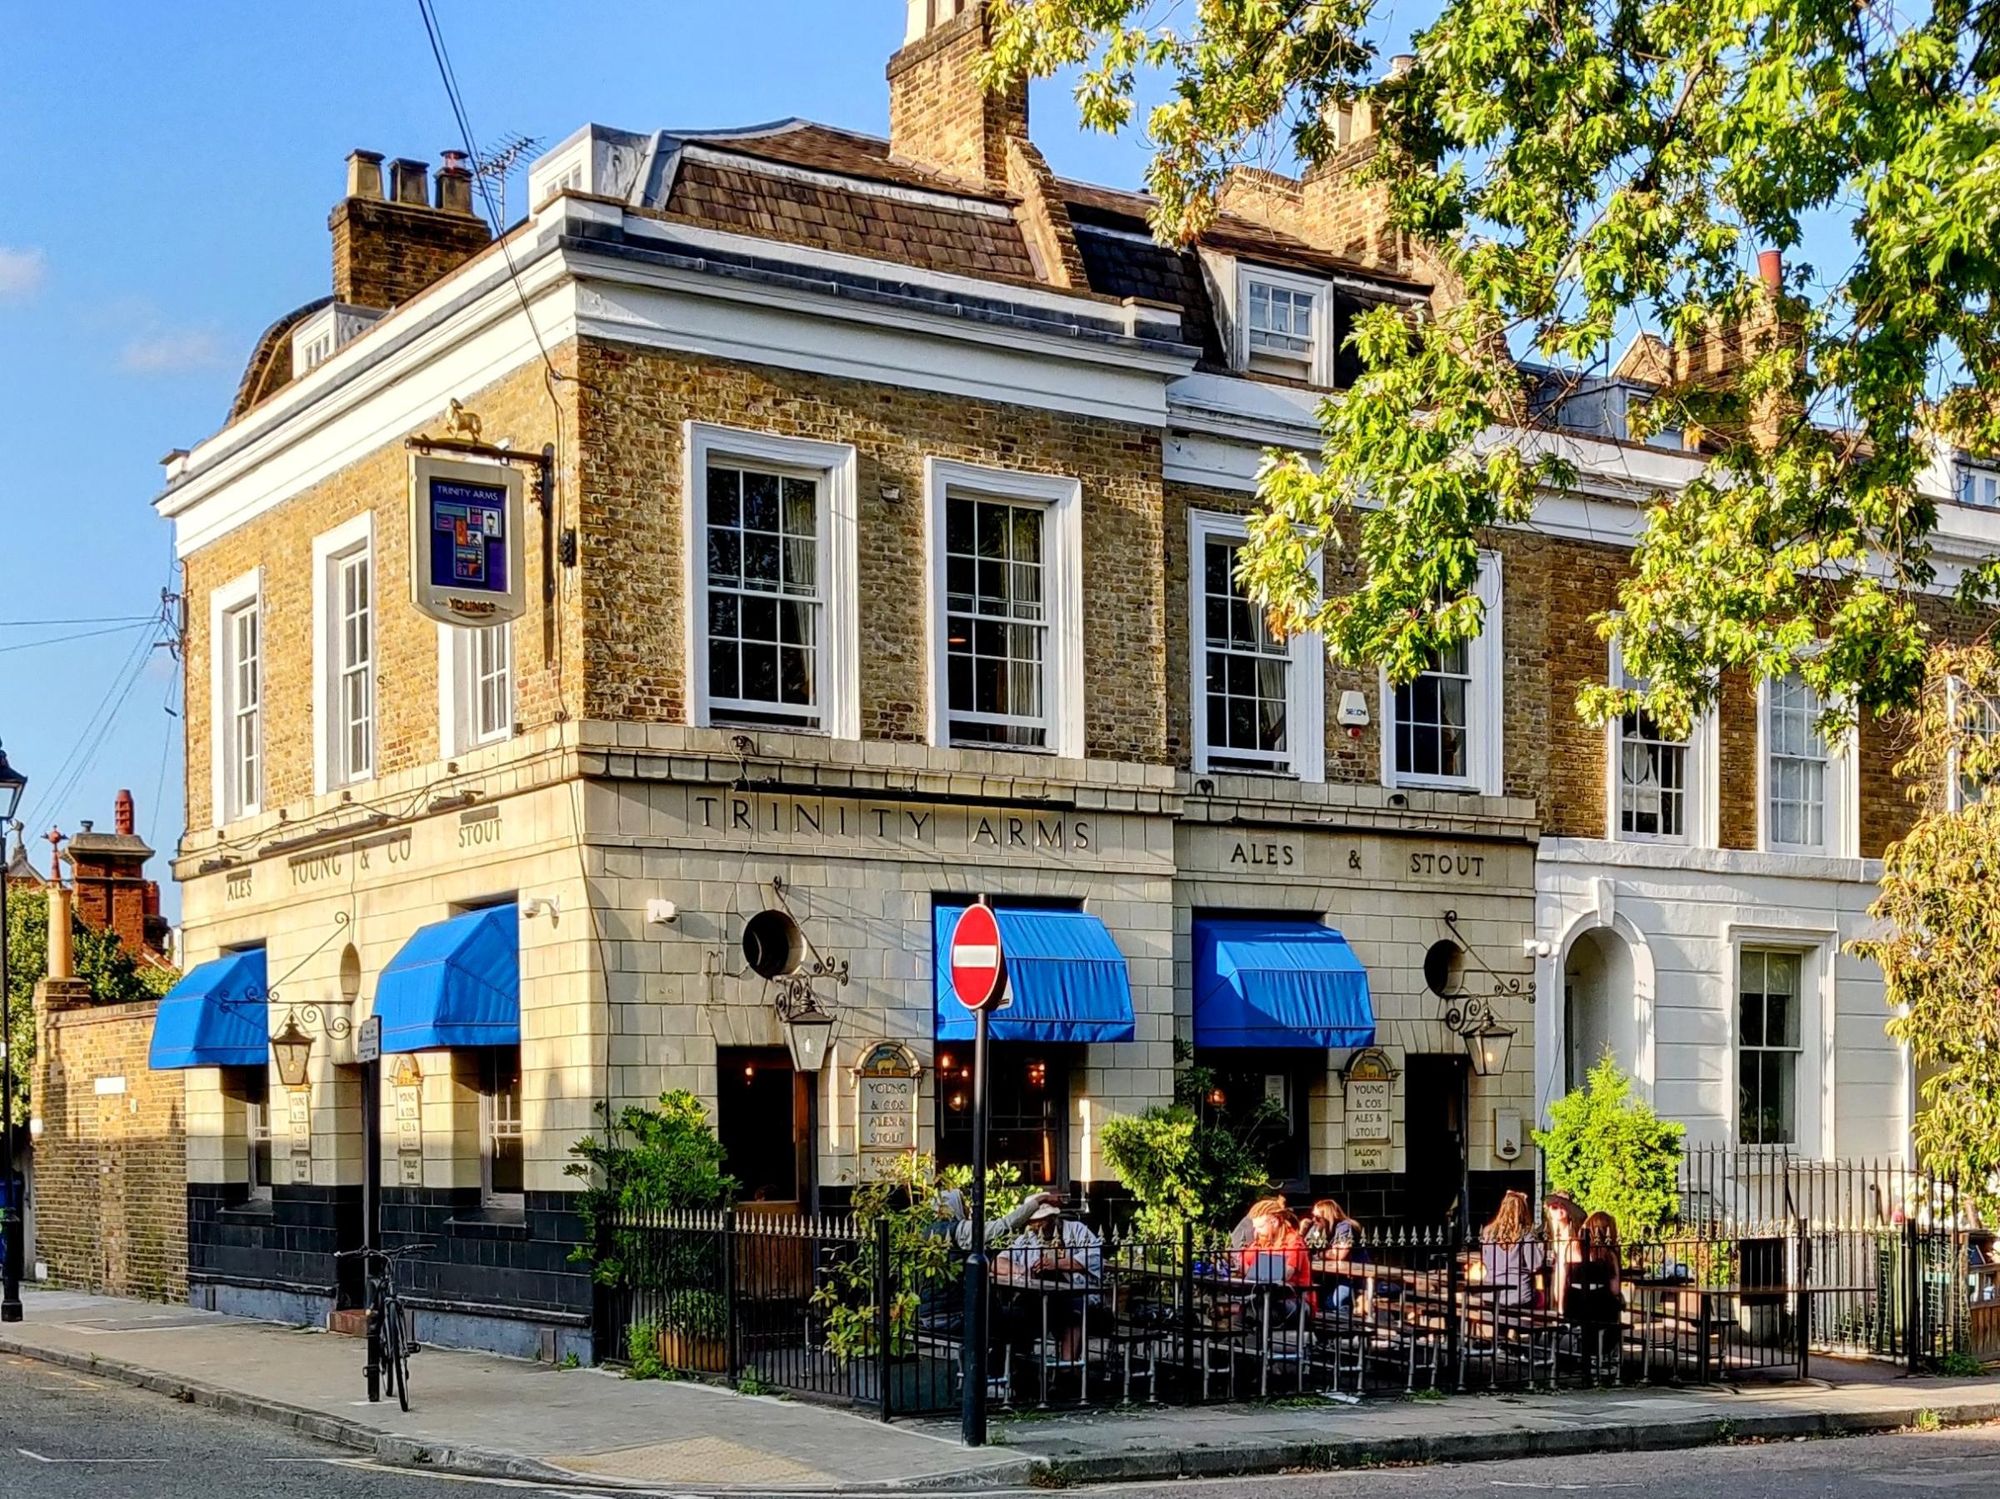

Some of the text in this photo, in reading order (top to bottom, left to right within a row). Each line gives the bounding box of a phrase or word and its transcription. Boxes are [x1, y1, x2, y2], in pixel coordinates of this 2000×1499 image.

[437, 485, 498, 501] TRINITY ARMS
[696, 797, 1089, 849] TRINITY ARMS
[226, 819, 502, 900] ALES YOUNG & CO STOUT
[1230, 843, 1484, 877] ALES & STOUT
[868, 1083, 907, 1094] YOUNG
[1354, 1085, 1384, 1094] YOUNG
[871, 1100, 878, 1110] &
[1356, 1099, 1362, 1108] &
[868, 1117, 905, 1127] ALES &
[1355, 1114, 1382, 1122] ALES &
[1355, 1127, 1381, 1137] STOUT
[870, 1133, 904, 1144] STOUT
[1354, 1148, 1382, 1157] SALOON
[1361, 1159, 1375, 1167] BAR
